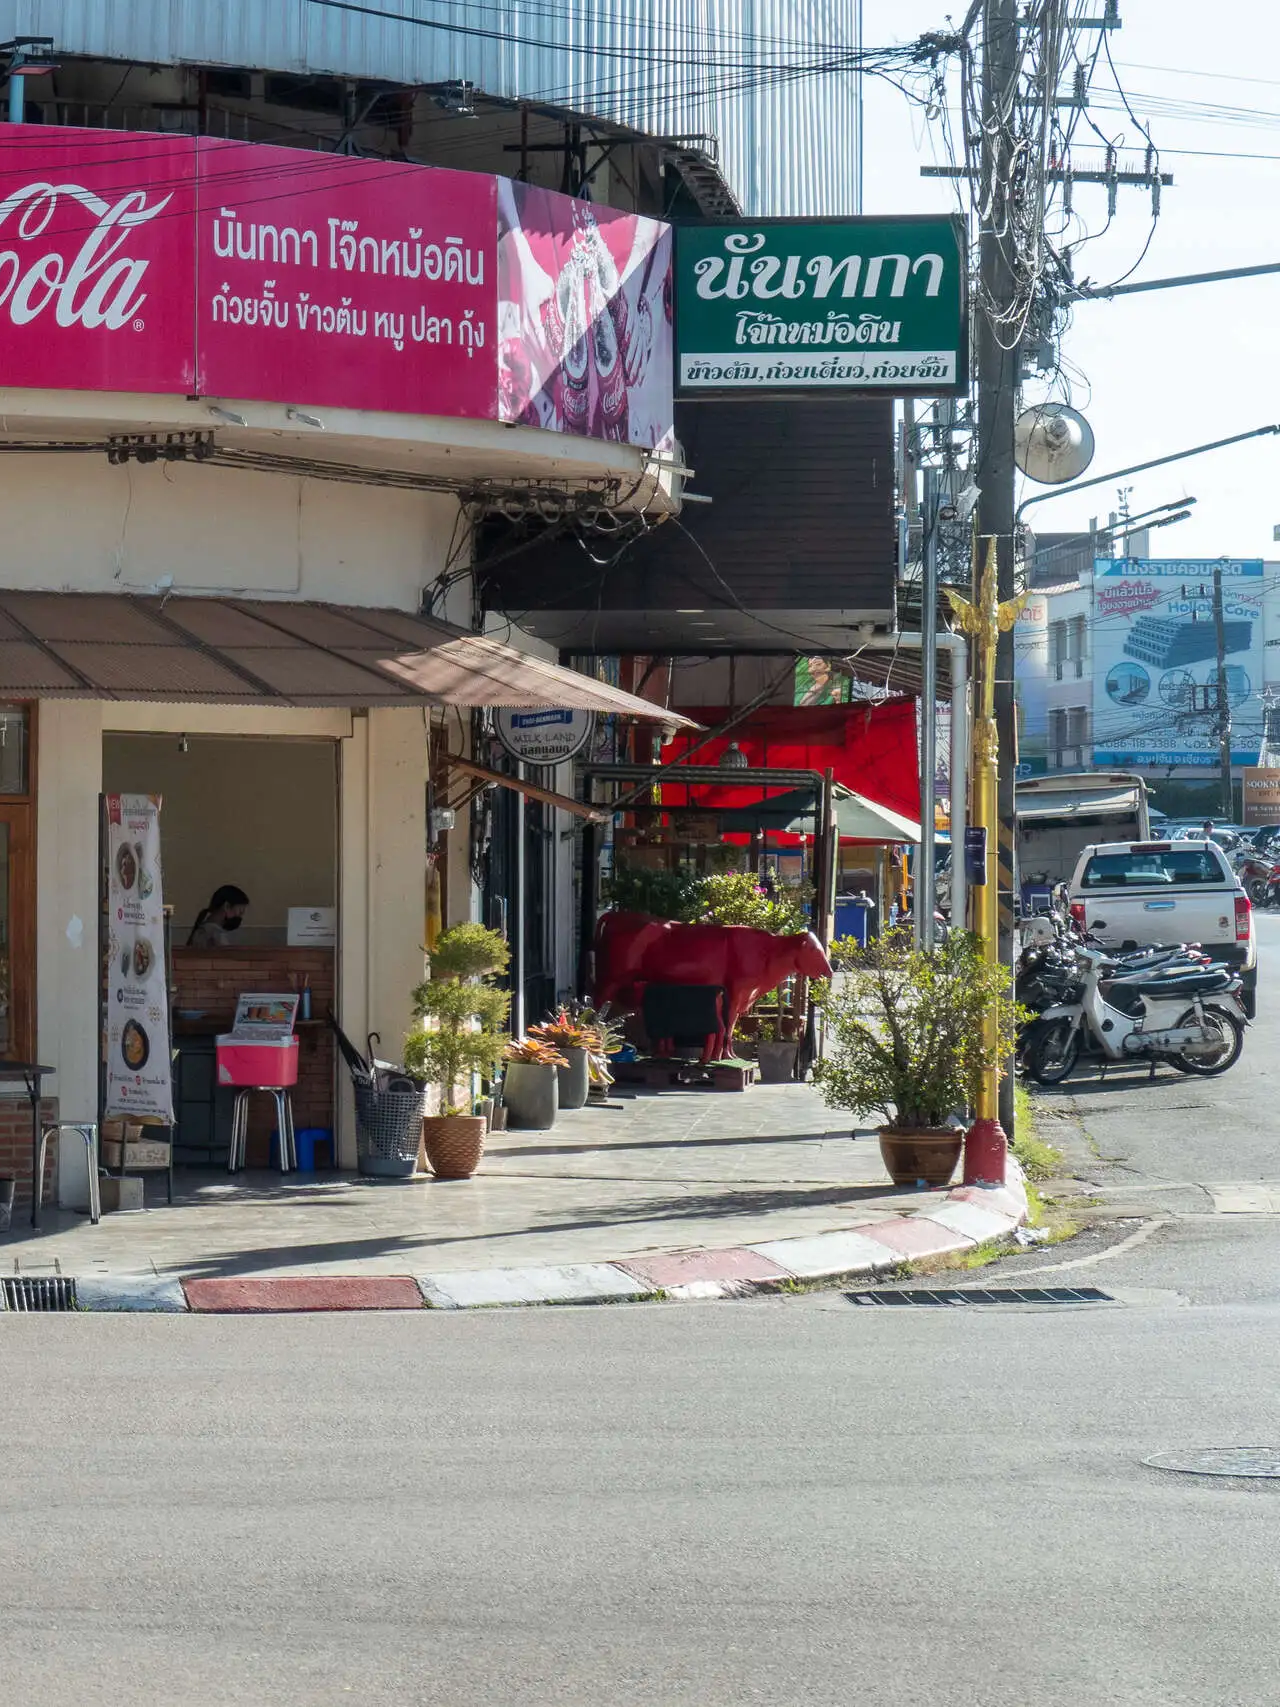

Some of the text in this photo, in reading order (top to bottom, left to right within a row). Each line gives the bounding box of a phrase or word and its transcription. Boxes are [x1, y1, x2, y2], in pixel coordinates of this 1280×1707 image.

[213, 207, 484, 285] นันทกา โจ๊กหม้อดิน
[694, 233, 944, 300] นันทกา
[212, 280, 484, 358] ก๋วยจั๊บ ข้าวต้ม หมู ปลา กุ้ง
[735, 310, 902, 345] โจ๊กหม้อดิน
[1224, 603, 1261, 619] Core
[546, 732, 576, 743] LAND
